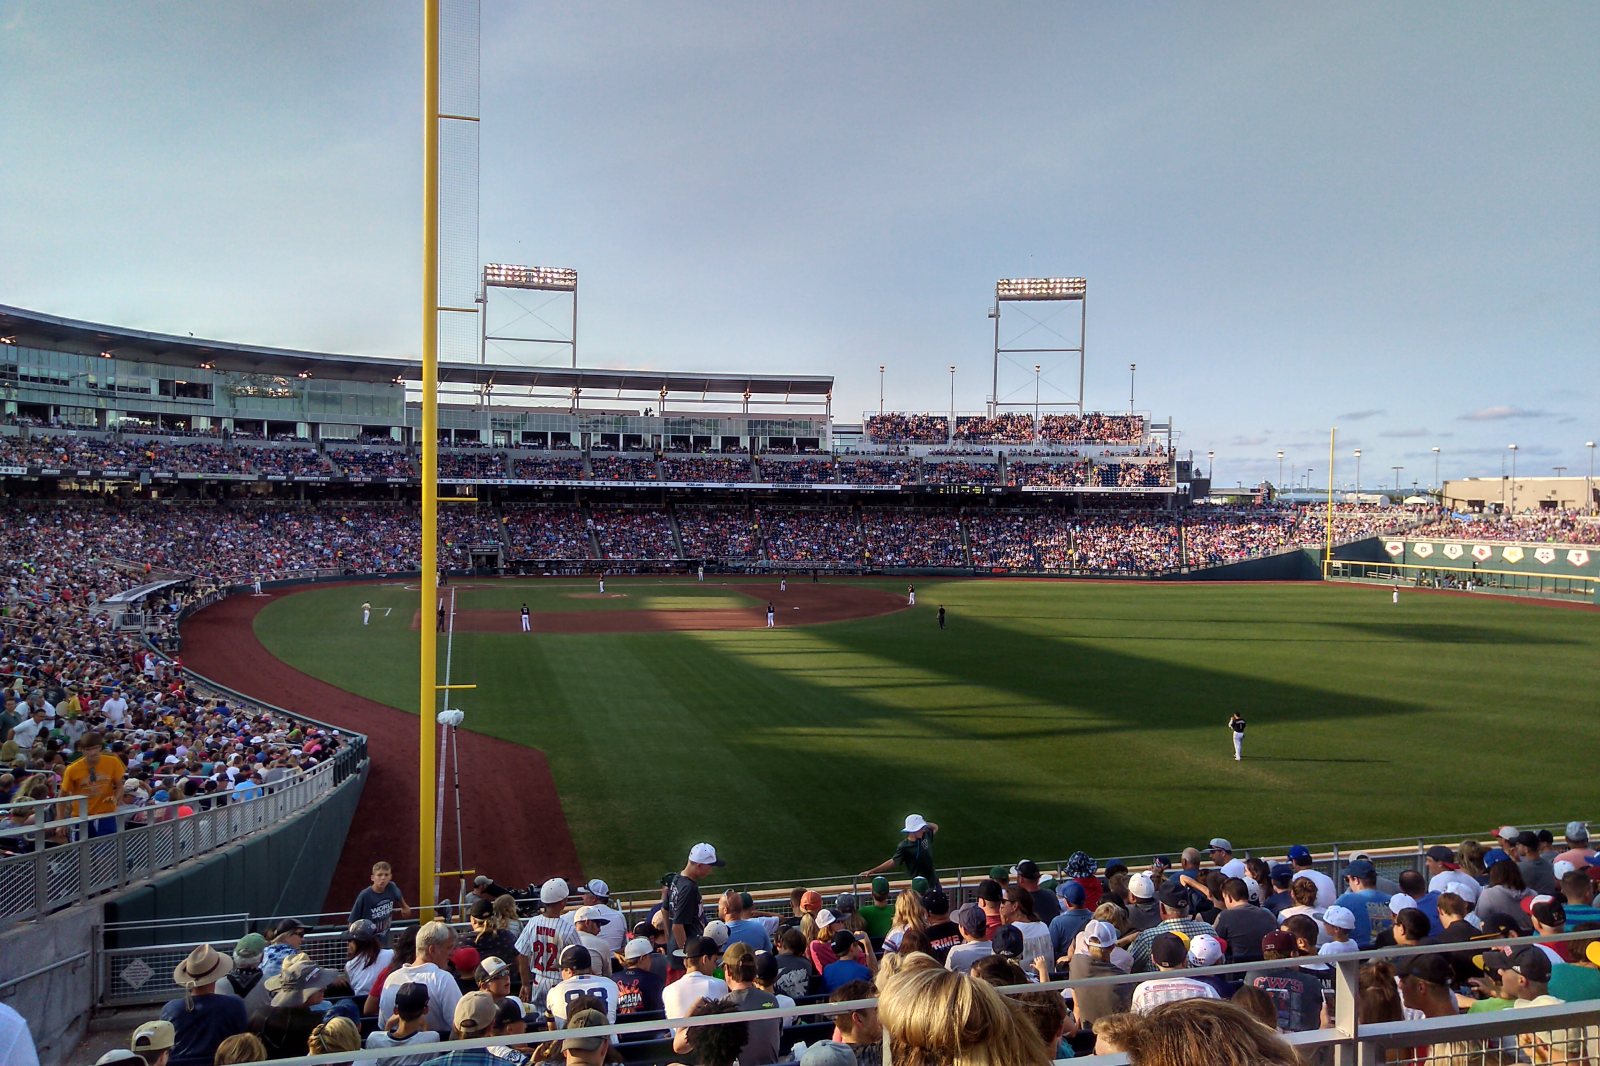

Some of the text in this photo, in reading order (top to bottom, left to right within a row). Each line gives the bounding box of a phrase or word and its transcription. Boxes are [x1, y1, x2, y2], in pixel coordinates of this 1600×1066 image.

[371, 901, 394, 914] WORLD
[533, 940, 559, 972] 22
[1253, 976, 1304, 993] CWS
